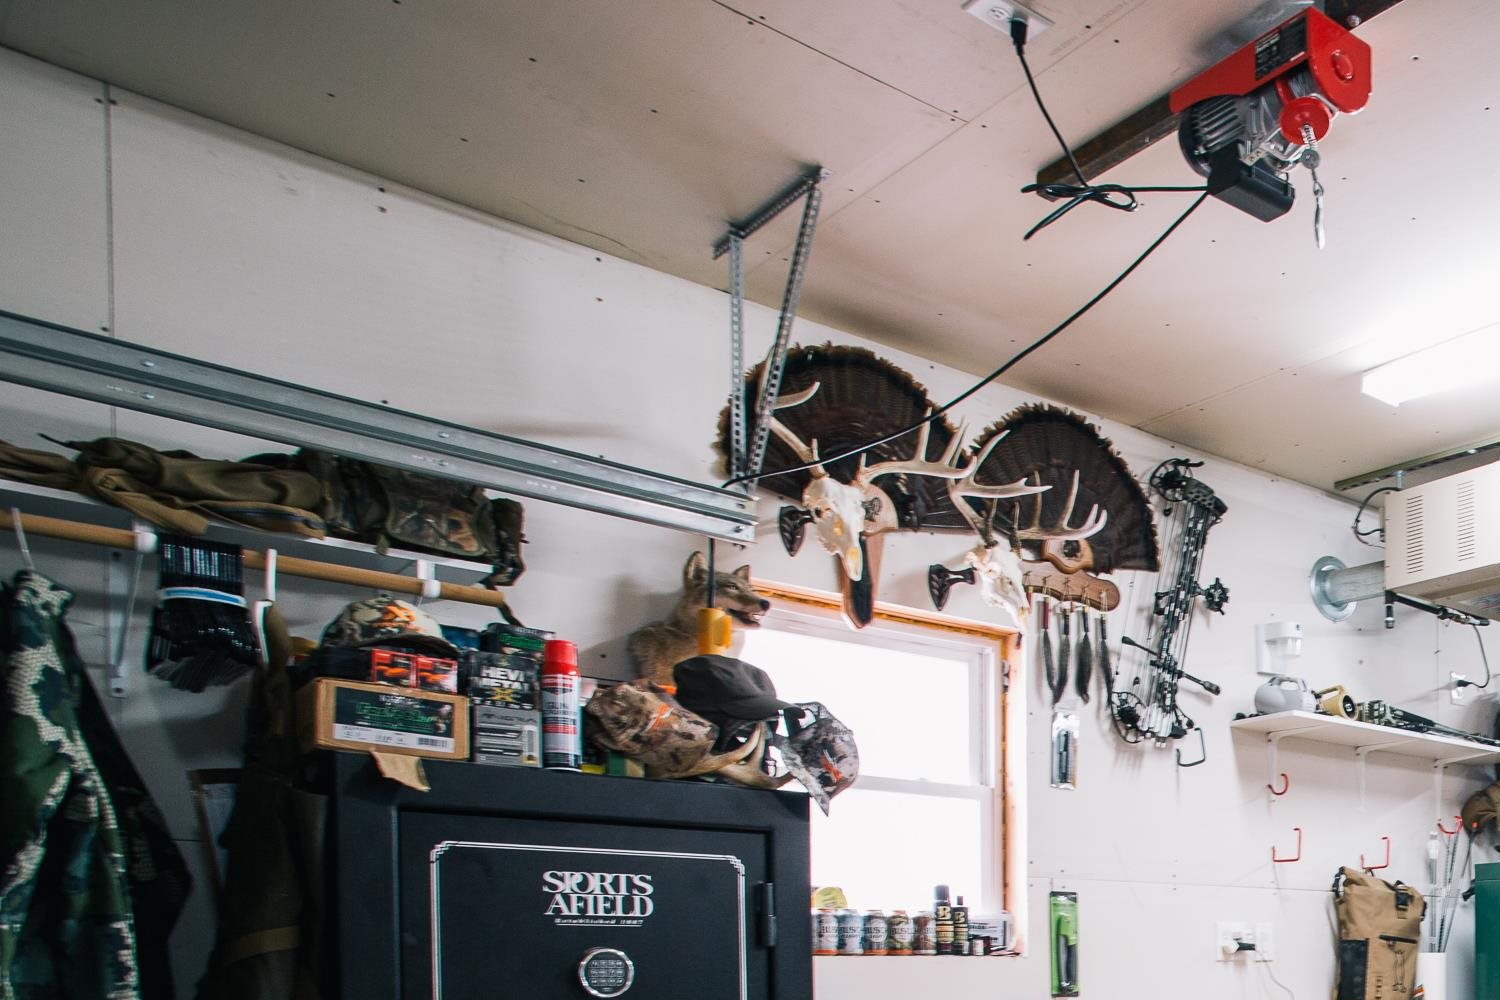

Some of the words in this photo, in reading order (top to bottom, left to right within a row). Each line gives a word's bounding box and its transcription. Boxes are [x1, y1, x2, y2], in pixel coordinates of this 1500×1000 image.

[481, 666, 526, 682] HEVI
[542, 870, 654, 896] SPORTS
[543, 893, 654, 917] AFIELD
[937, 905, 951, 920] B
[954, 911, 966, 923] B
